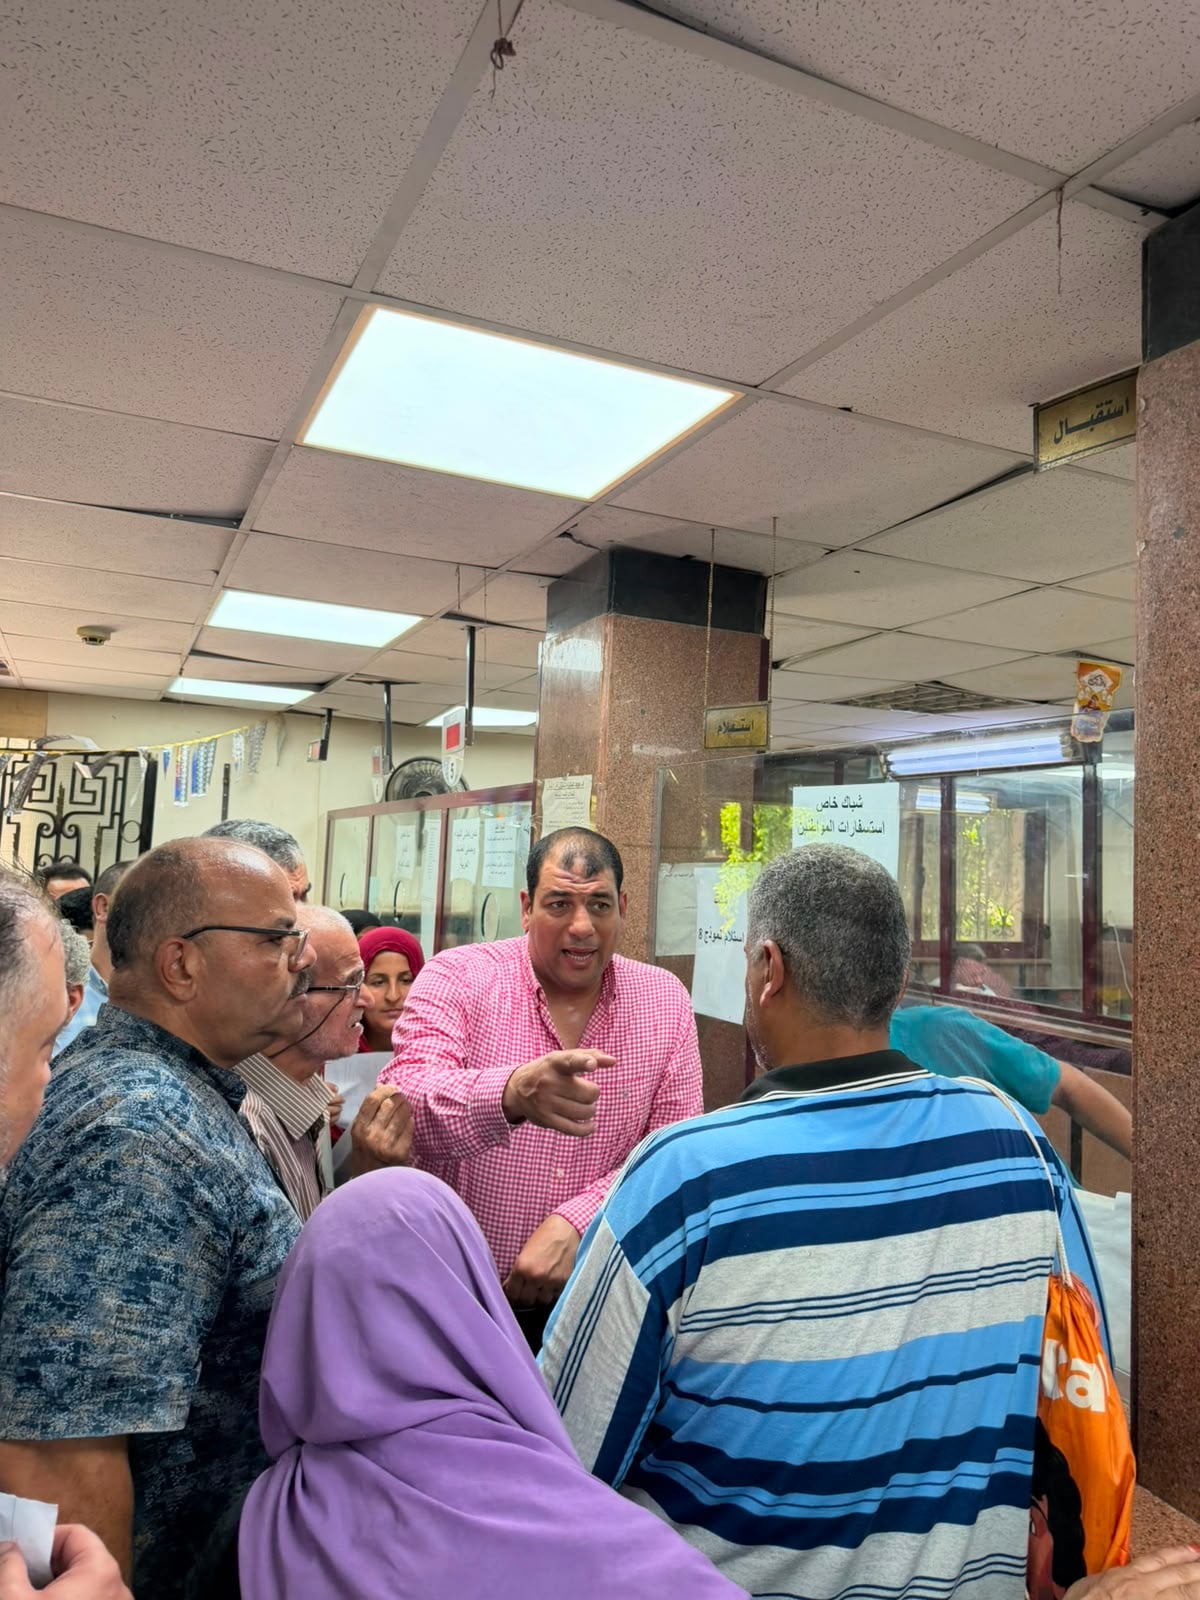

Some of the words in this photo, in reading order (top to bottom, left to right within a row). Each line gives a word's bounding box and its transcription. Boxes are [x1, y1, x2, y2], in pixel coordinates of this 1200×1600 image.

[1053, 397, 1130, 444] استقبال
[717, 718, 754, 736] استعلام
[816, 796, 838, 812] خاص
[841, 795, 864, 812] شباك
[704, 926, 722, 943] نموذج
